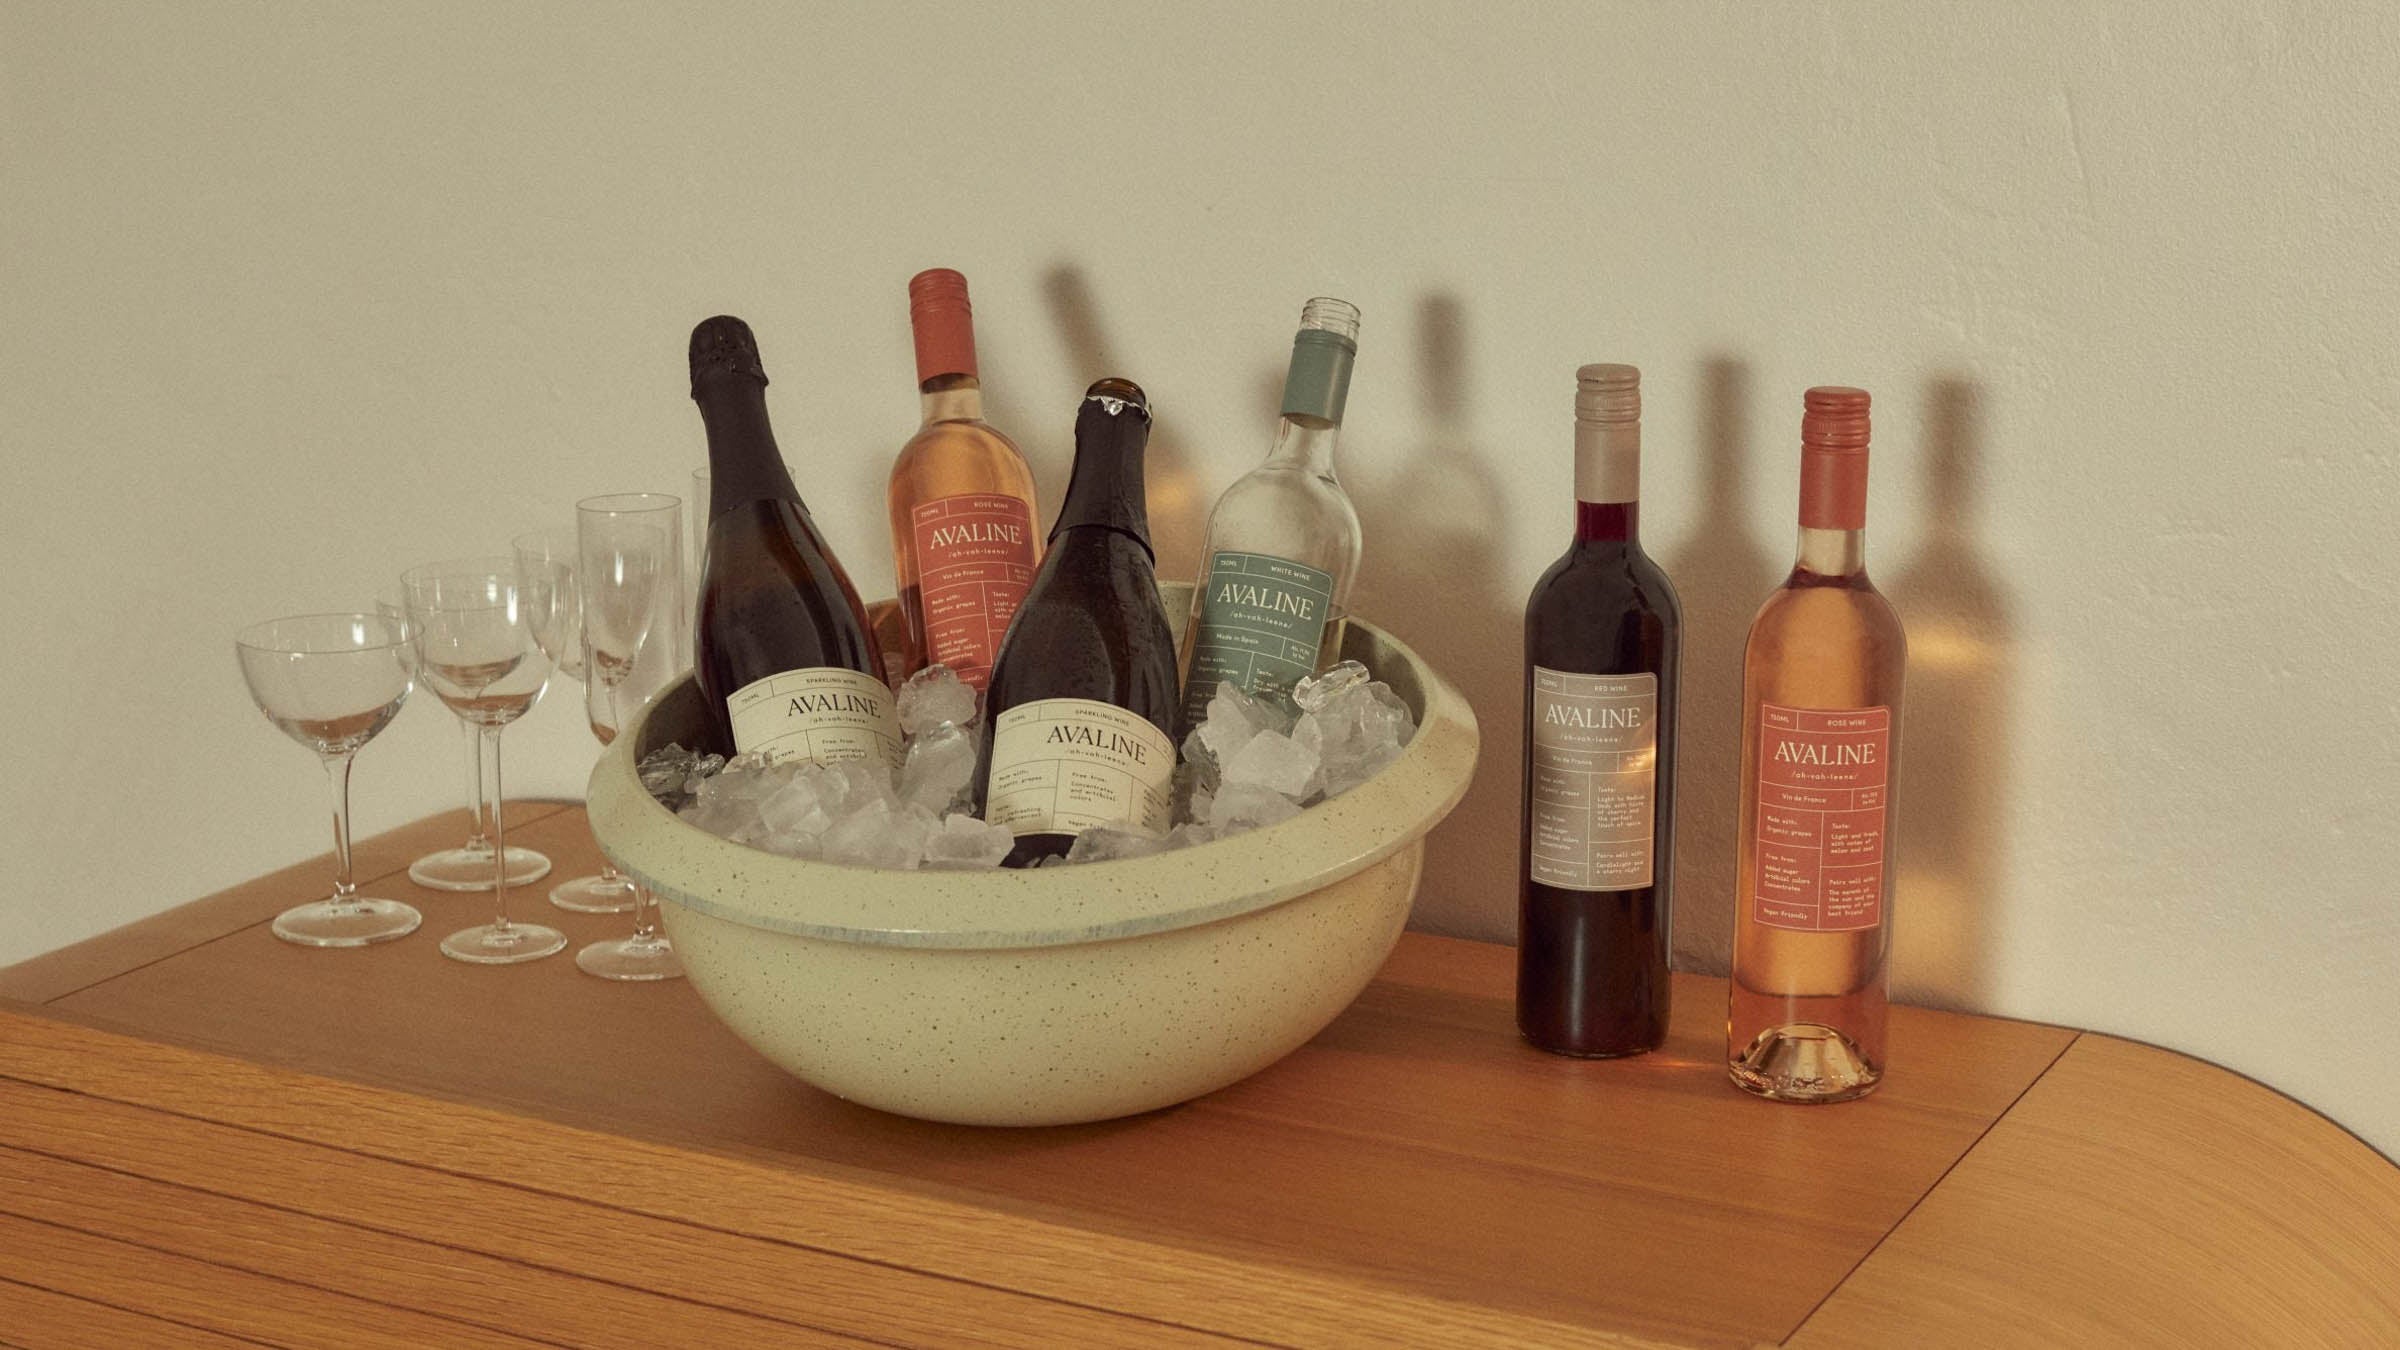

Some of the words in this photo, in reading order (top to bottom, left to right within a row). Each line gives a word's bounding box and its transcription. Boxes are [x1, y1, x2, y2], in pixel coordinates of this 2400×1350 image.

[930, 523, 1022, 550] AVALINE
[1271, 566, 1292, 576] WHITE
[1294, 572, 1310, 581] WINE
[1217, 584, 1314, 620] AVALINE
[788, 694, 880, 718] AVALINE
[1075, 709, 1112, 721] SPARKLING
[1114, 716, 1129, 726] WINE
[1545, 704, 1640, 728] AVALINE
[1048, 725, 1146, 765] AVALINE
[1774, 741, 1876, 765] AVALINE
